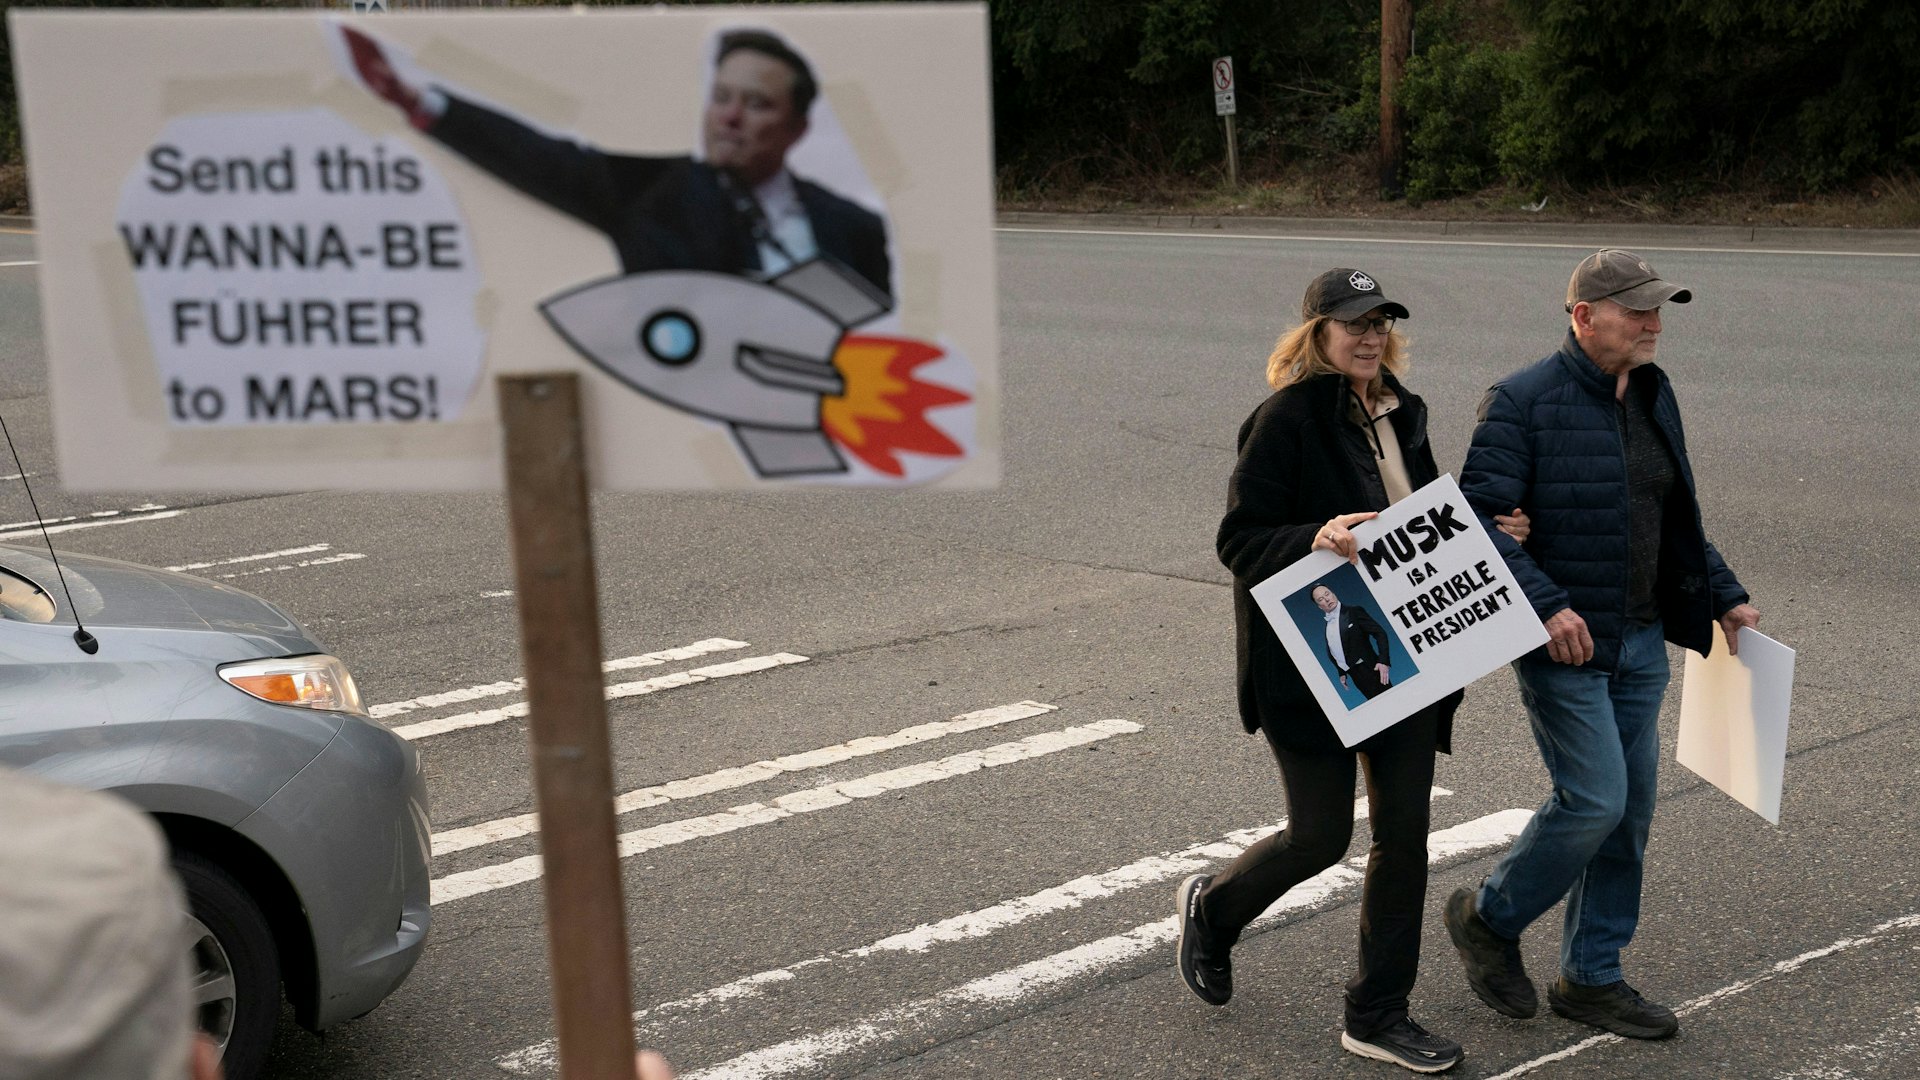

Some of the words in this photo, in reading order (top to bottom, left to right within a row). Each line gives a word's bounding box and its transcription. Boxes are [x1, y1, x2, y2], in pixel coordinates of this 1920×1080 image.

[147, 145, 294, 194] Send
[318, 145, 423, 193] this
[121, 223, 462, 270] WANNA-BE
[172, 292, 425, 345] FÜHRER
[168, 378, 224, 421] to
[247, 376, 441, 421] MARS!
[1357, 502, 1469, 582] MUSK
[1391, 559, 1497, 629] TERRIBLE
[1407, 567, 1425, 587] IS
[1426, 561, 1438, 578] A
[1409, 585, 1512, 655] PRESIDENT
